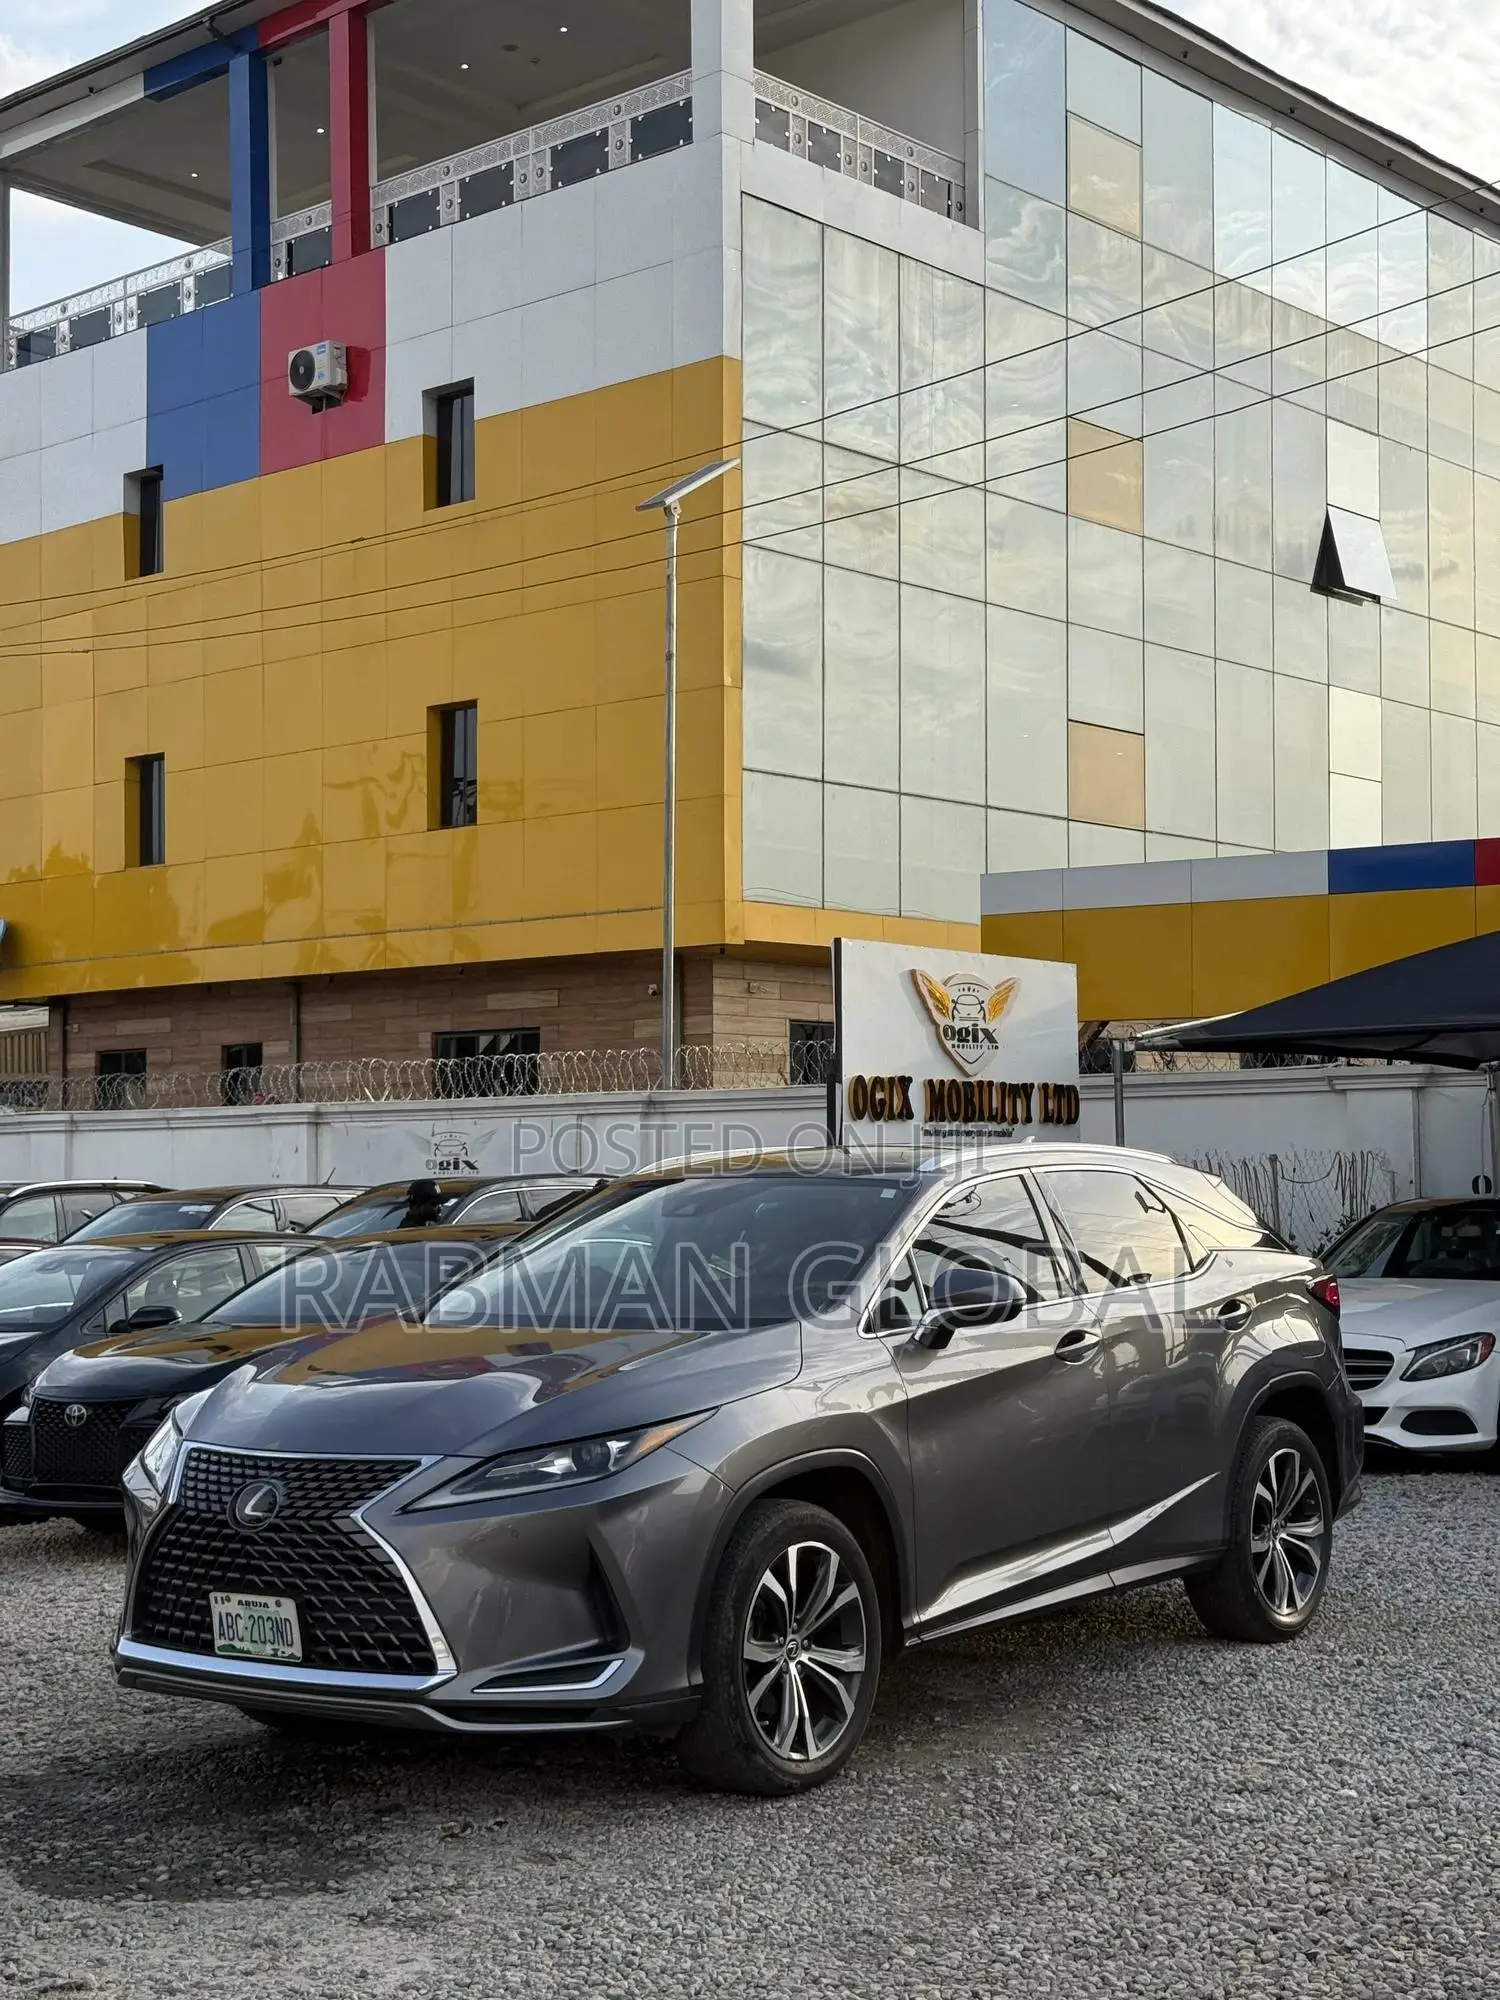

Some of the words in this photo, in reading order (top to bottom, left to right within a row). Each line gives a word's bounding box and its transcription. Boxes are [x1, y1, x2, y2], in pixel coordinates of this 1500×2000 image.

[848, 1075, 914, 1121] OGIX
[923, 1079, 1035, 1125] MOBILITY
[1037, 1082, 1080, 1125] LTD
